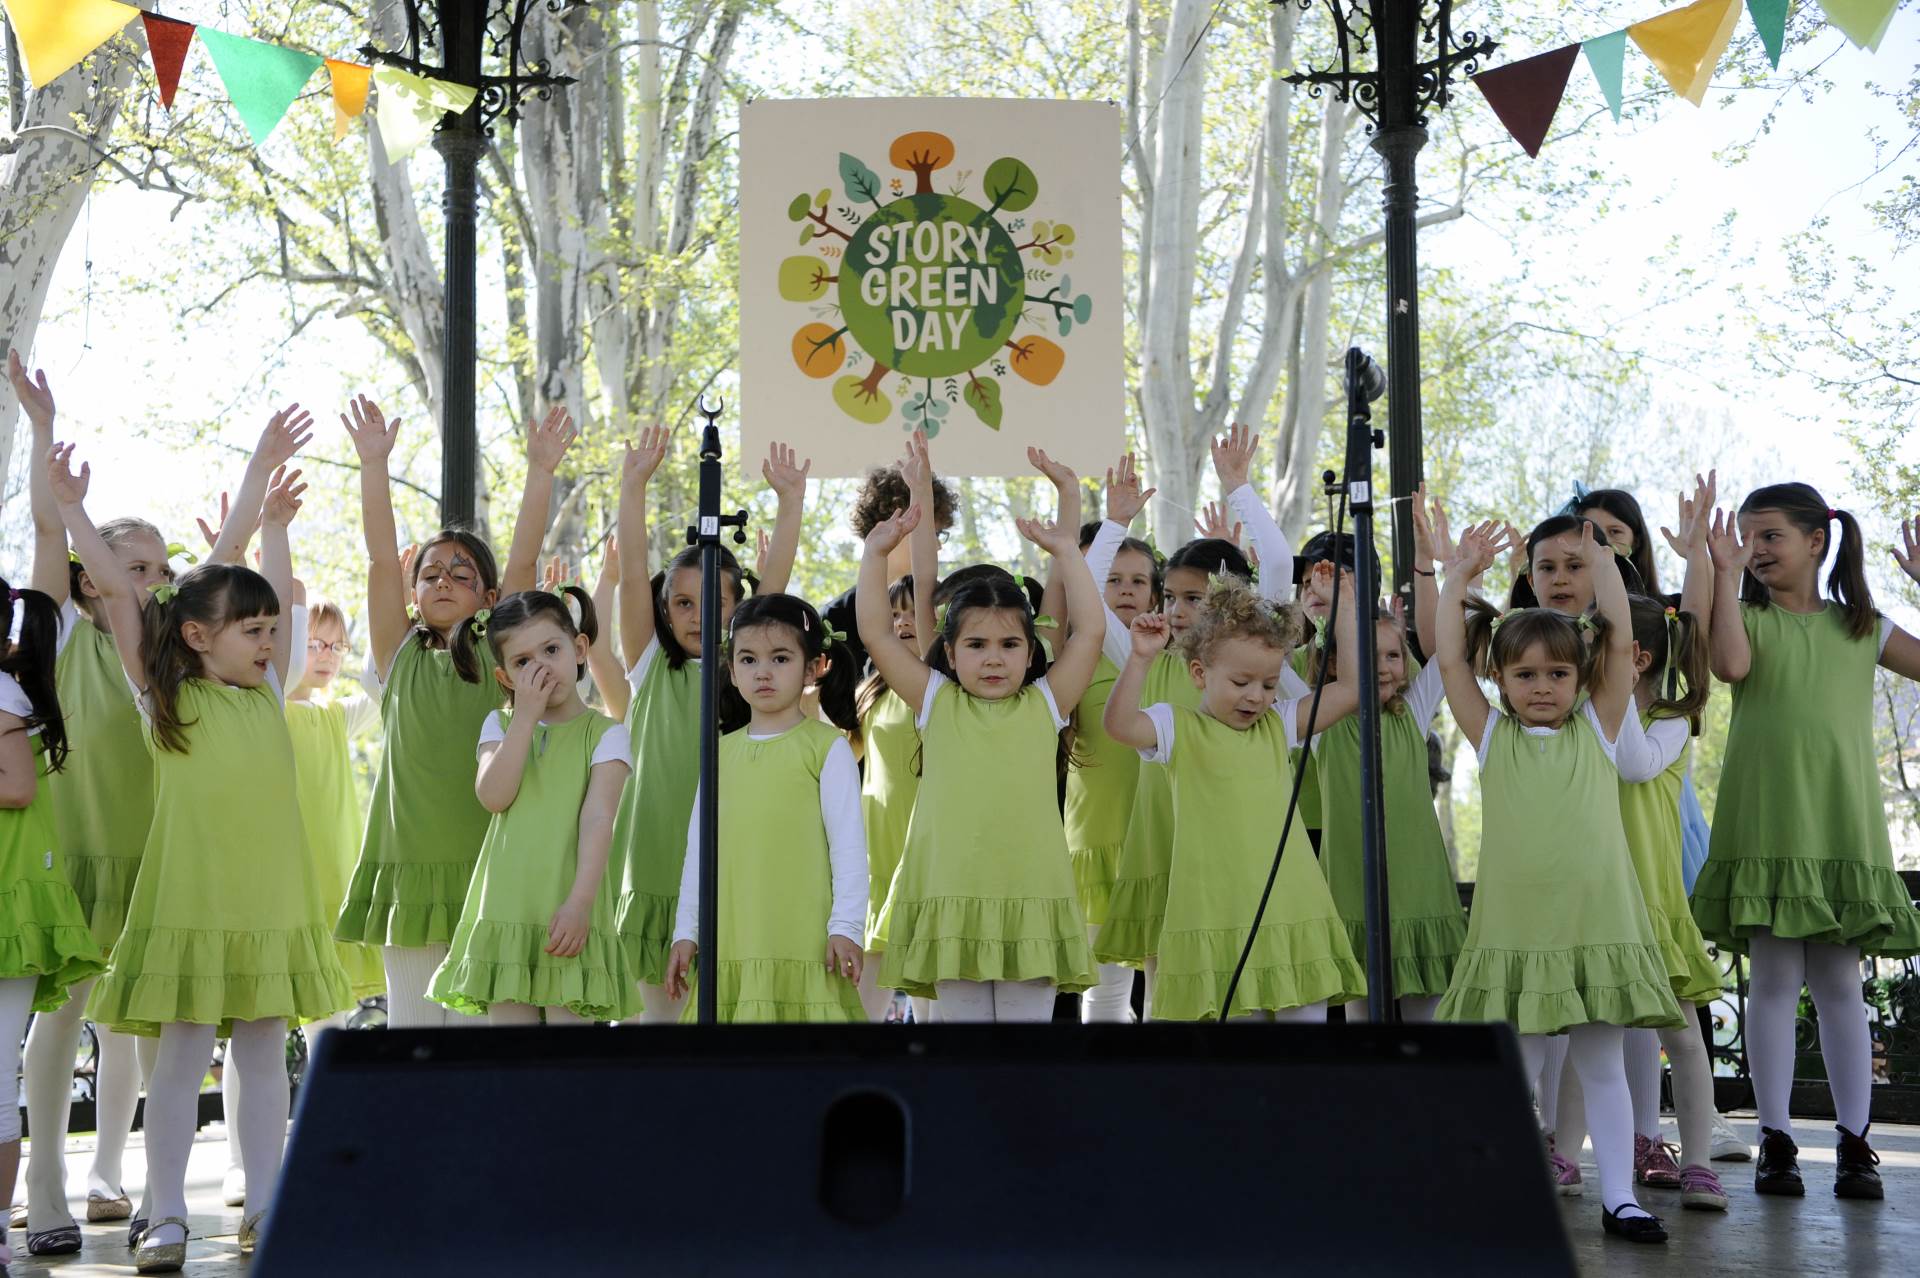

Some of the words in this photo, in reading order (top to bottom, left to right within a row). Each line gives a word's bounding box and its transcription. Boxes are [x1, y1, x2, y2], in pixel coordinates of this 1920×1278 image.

[865, 221, 990, 264] STORY
[861, 266, 997, 307] GREEN
[892, 309, 972, 352] DAY
